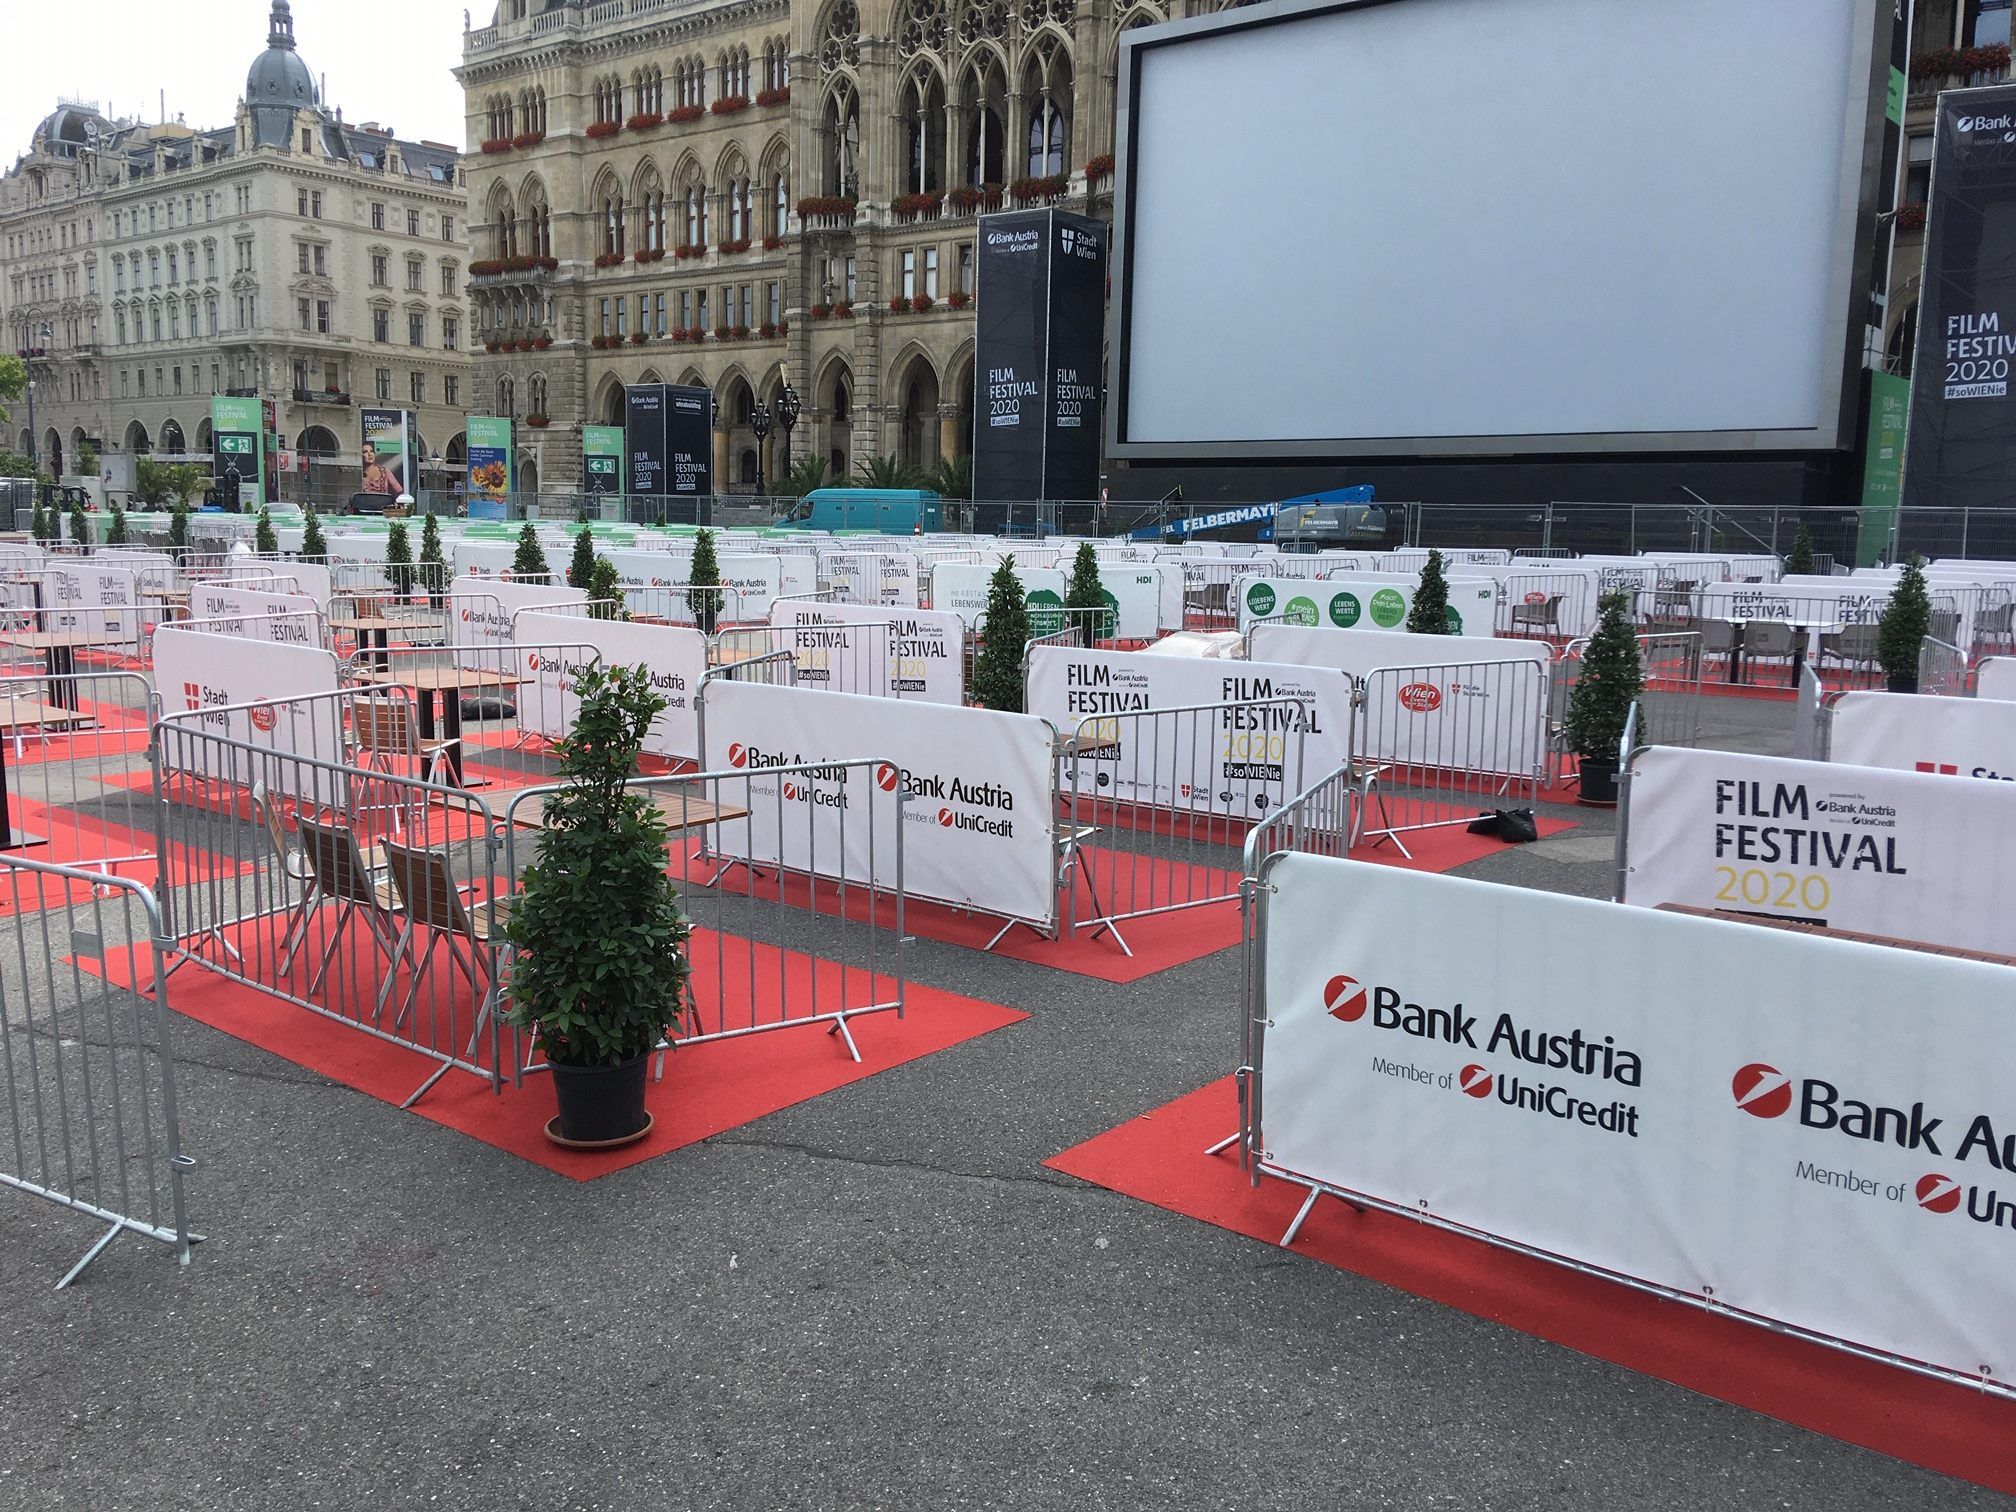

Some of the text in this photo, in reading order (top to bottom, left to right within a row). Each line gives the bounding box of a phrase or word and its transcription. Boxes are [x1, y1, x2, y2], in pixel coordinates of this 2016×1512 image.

[1975, 114, 2012, 131] Bank
[996, 230, 1039, 243] Bank Austria
[1077, 232, 1097, 248] Stadt
[1077, 245, 1097, 260] Wien
[1948, 312, 2000, 336] FILM
[989, 367, 1014, 383] FILM
[1057, 368, 1077, 383] FILM
[1945, 358, 2009, 382] 2020
[990, 381, 1038, 399] FESTIVAL
[1057, 385, 1096, 400] FESTIVAL
[1947, 385, 2005, 397] #soWIENie
[991, 399, 1020, 415] 2020
[1057, 401, 1081, 415] 2020
[364, 422, 394, 430] FESTIVAL
[634, 452, 649, 462] FILM
[674, 453, 692, 463] FILM
[635, 461, 661, 472] FESTIVAL
[675, 464, 707, 473] FESTIVAL
[635, 472, 652, 482] 2020
[676, 474, 696, 483] 2020
[881, 568, 910, 578] FESTIVAL
[1136, 576, 1152, 584] HDI
[99, 576, 114, 589] FILM
[627, 576, 643, 586] Austria
[658, 579, 672, 587] Bank
[730, 579, 768, 590] Bank Austria
[101, 592, 128, 604] FESTIVAL
[748, 589, 768, 597] UniCredit
[1478, 590, 1492, 599] HDI
[207, 597, 225, 613] FILM
[951, 600, 988, 610] LEBENSWER
[1254, 604, 1270, 612] WERT
[1334, 600, 1356, 608] LEBENS
[1335, 607, 1355, 615] WERTE
[470, 610, 485, 623] Bank
[1732, 605, 1793, 618] FESTIVAL
[271, 624, 309, 641] FESTIVAL
[796, 632, 850, 649] FESTIVAL
[540, 656, 560, 673] Bank
[1068, 664, 1149, 686] FILM Bank Austria
[653, 670, 686, 695] Austria
[1223, 678, 1273, 701] FILM
[203, 686, 229, 704] Stadt
[1282, 688, 1316, 700] Bank Austria
[1405, 686, 1436, 699] Wien
[1223, 706, 1322, 734] FESTIVAL
[1223, 735, 1284, 761] 2020
[749, 746, 788, 771] Bank
[901, 769, 1013, 811] Bank Austria
[1192, 785, 1209, 794] Stadt
[1192, 794, 1209, 802] Wien
[1716, 780, 1809, 821] FILM
[1830, 793, 1866, 801] powered by
[1829, 801, 1897, 817] Bank Austria
[929, 814, 936, 825] of
[955, 811, 1013, 839] UniCredit
[1861, 819, 1896, 829] UniCredit
[1716, 824, 1907, 875] FESTIVAL
[1714, 866, 1831, 912] 2020
[1373, 986, 1642, 1088] Bank Austria
[1372, 1056, 1640, 1138] Member of UniCredit
[1800, 1078, 1944, 1157] Bank
[1796, 1160, 1906, 1203] Member of
